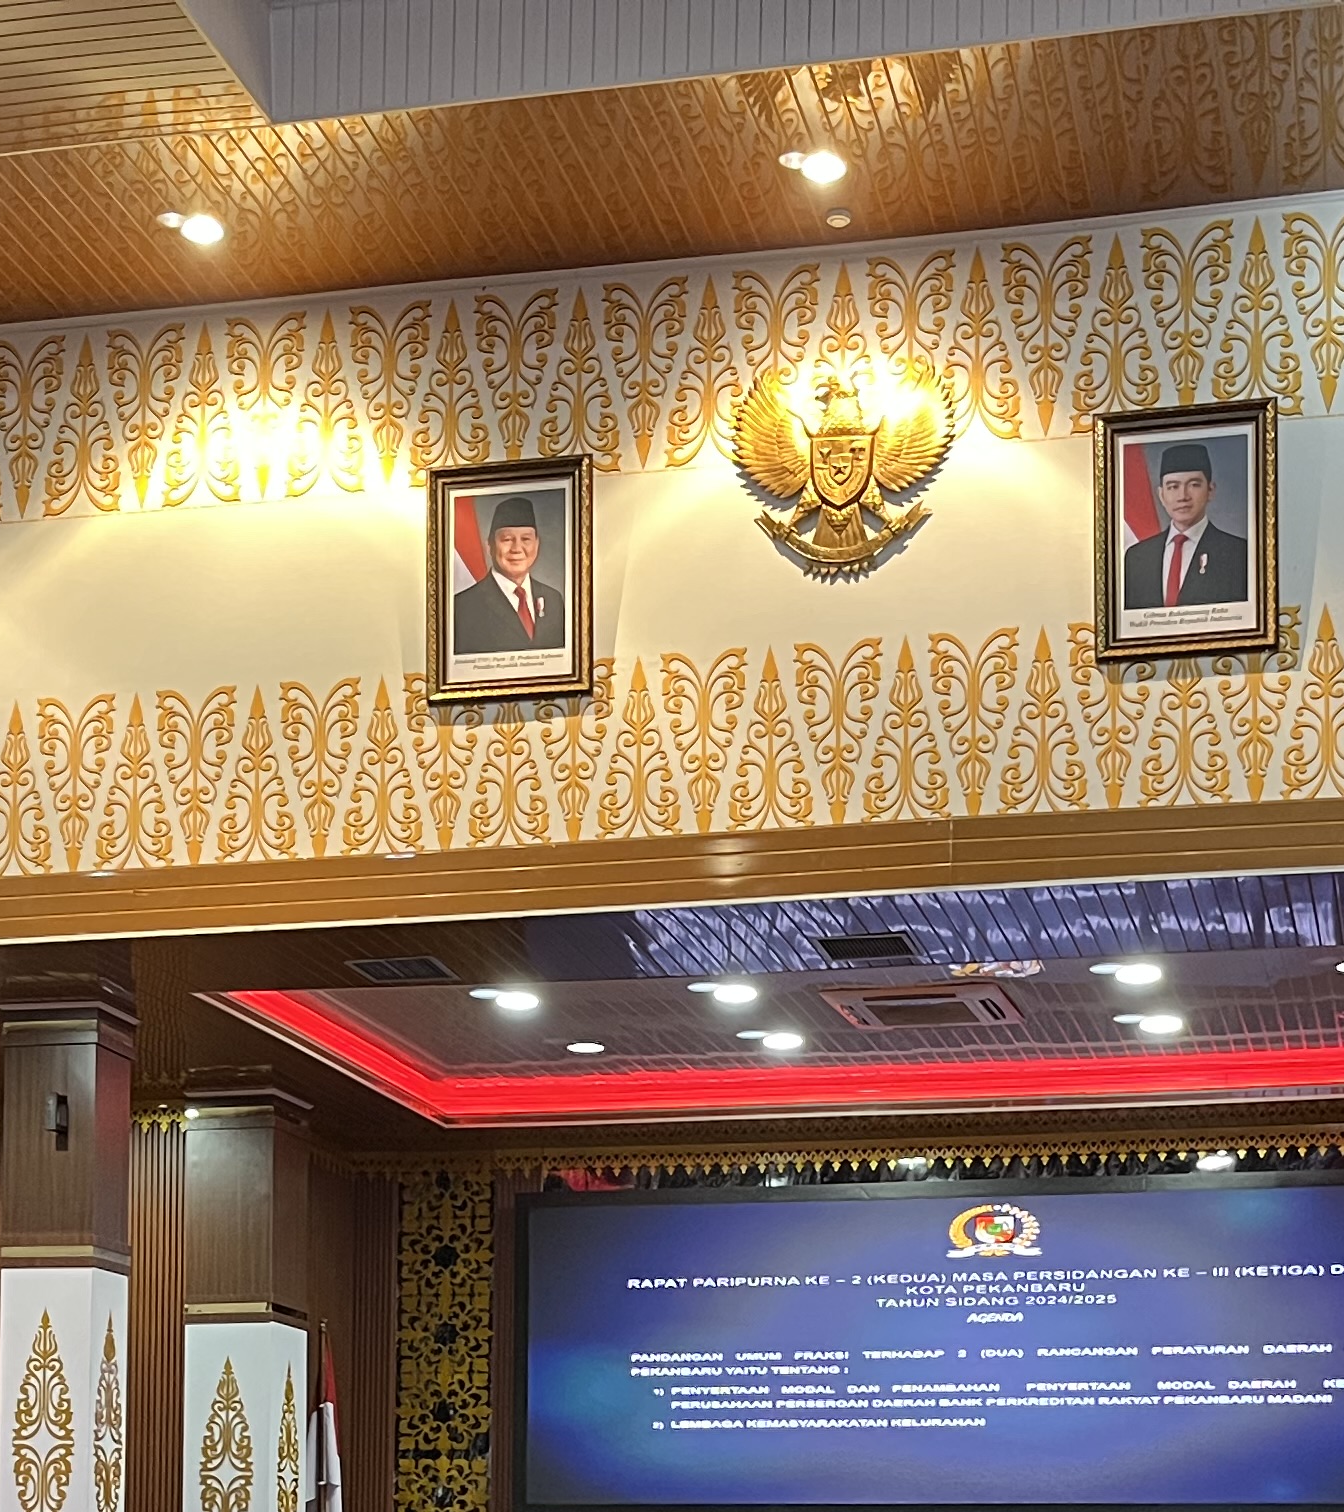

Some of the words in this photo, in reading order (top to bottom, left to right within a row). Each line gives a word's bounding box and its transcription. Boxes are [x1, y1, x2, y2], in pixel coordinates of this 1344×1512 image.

[627, 1277, 688, 1290] RAPAT
[693, 1275, 801, 1289] PARIPURNA
[805, 1275, 831, 1286] KE
[852, 1275, 862, 1285] 2
[867, 1272, 946, 1286] (KEDUA)
[952, 1270, 1008, 1284] MASA
[1013, 1267, 1157, 1281] PERSIDANGAN
[1163, 1267, 1191, 1279] KE
[1234, 1265, 1326, 1278] (KETIGA)
[906, 1284, 958, 1295] KOTA
[962, 1281, 1086, 1295] PEKANBARU
[876, 1297, 940, 1309] TAHUN
[945, 1295, 1019, 1308] SIDANG
[1025, 1294, 1118, 1306] 2024/2025
[966, 1311, 1025, 1324] AGENDA
[630, 1352, 725, 1364] PANDANGAN
[735, 1351, 783, 1362] UMUM
[862, 1349, 946, 1361] TERHADAP
[980, 1347, 1025, 1360] (DUA)
[1037, 1346, 1139, 1358] RANCANGAN
[1151, 1345, 1250, 1356] PERATURAN
[1262, 1343, 1333, 1355] DAERAH
[630, 1365, 723, 1378] PEKANBARU
[771, 1364, 841, 1376] TENTANG
[670, 1384, 770, 1396] PENYERTAAN
[780, 1384, 836, 1396] MODAL
[847, 1383, 881, 1395] DAN
[1026, 1381, 1132, 1392] PENYERTAAN
[1156, 1380, 1216, 1391] MODAL
[1228, 1378, 1297, 1390] DAERAH
[871, 1398, 937, 1409] DAERAH
[938, 1397, 984, 1408] BANK
[1098, 1395, 1161, 1407] RAKYAT
[1163, 1394, 1265, 1406] PEKANBARU
